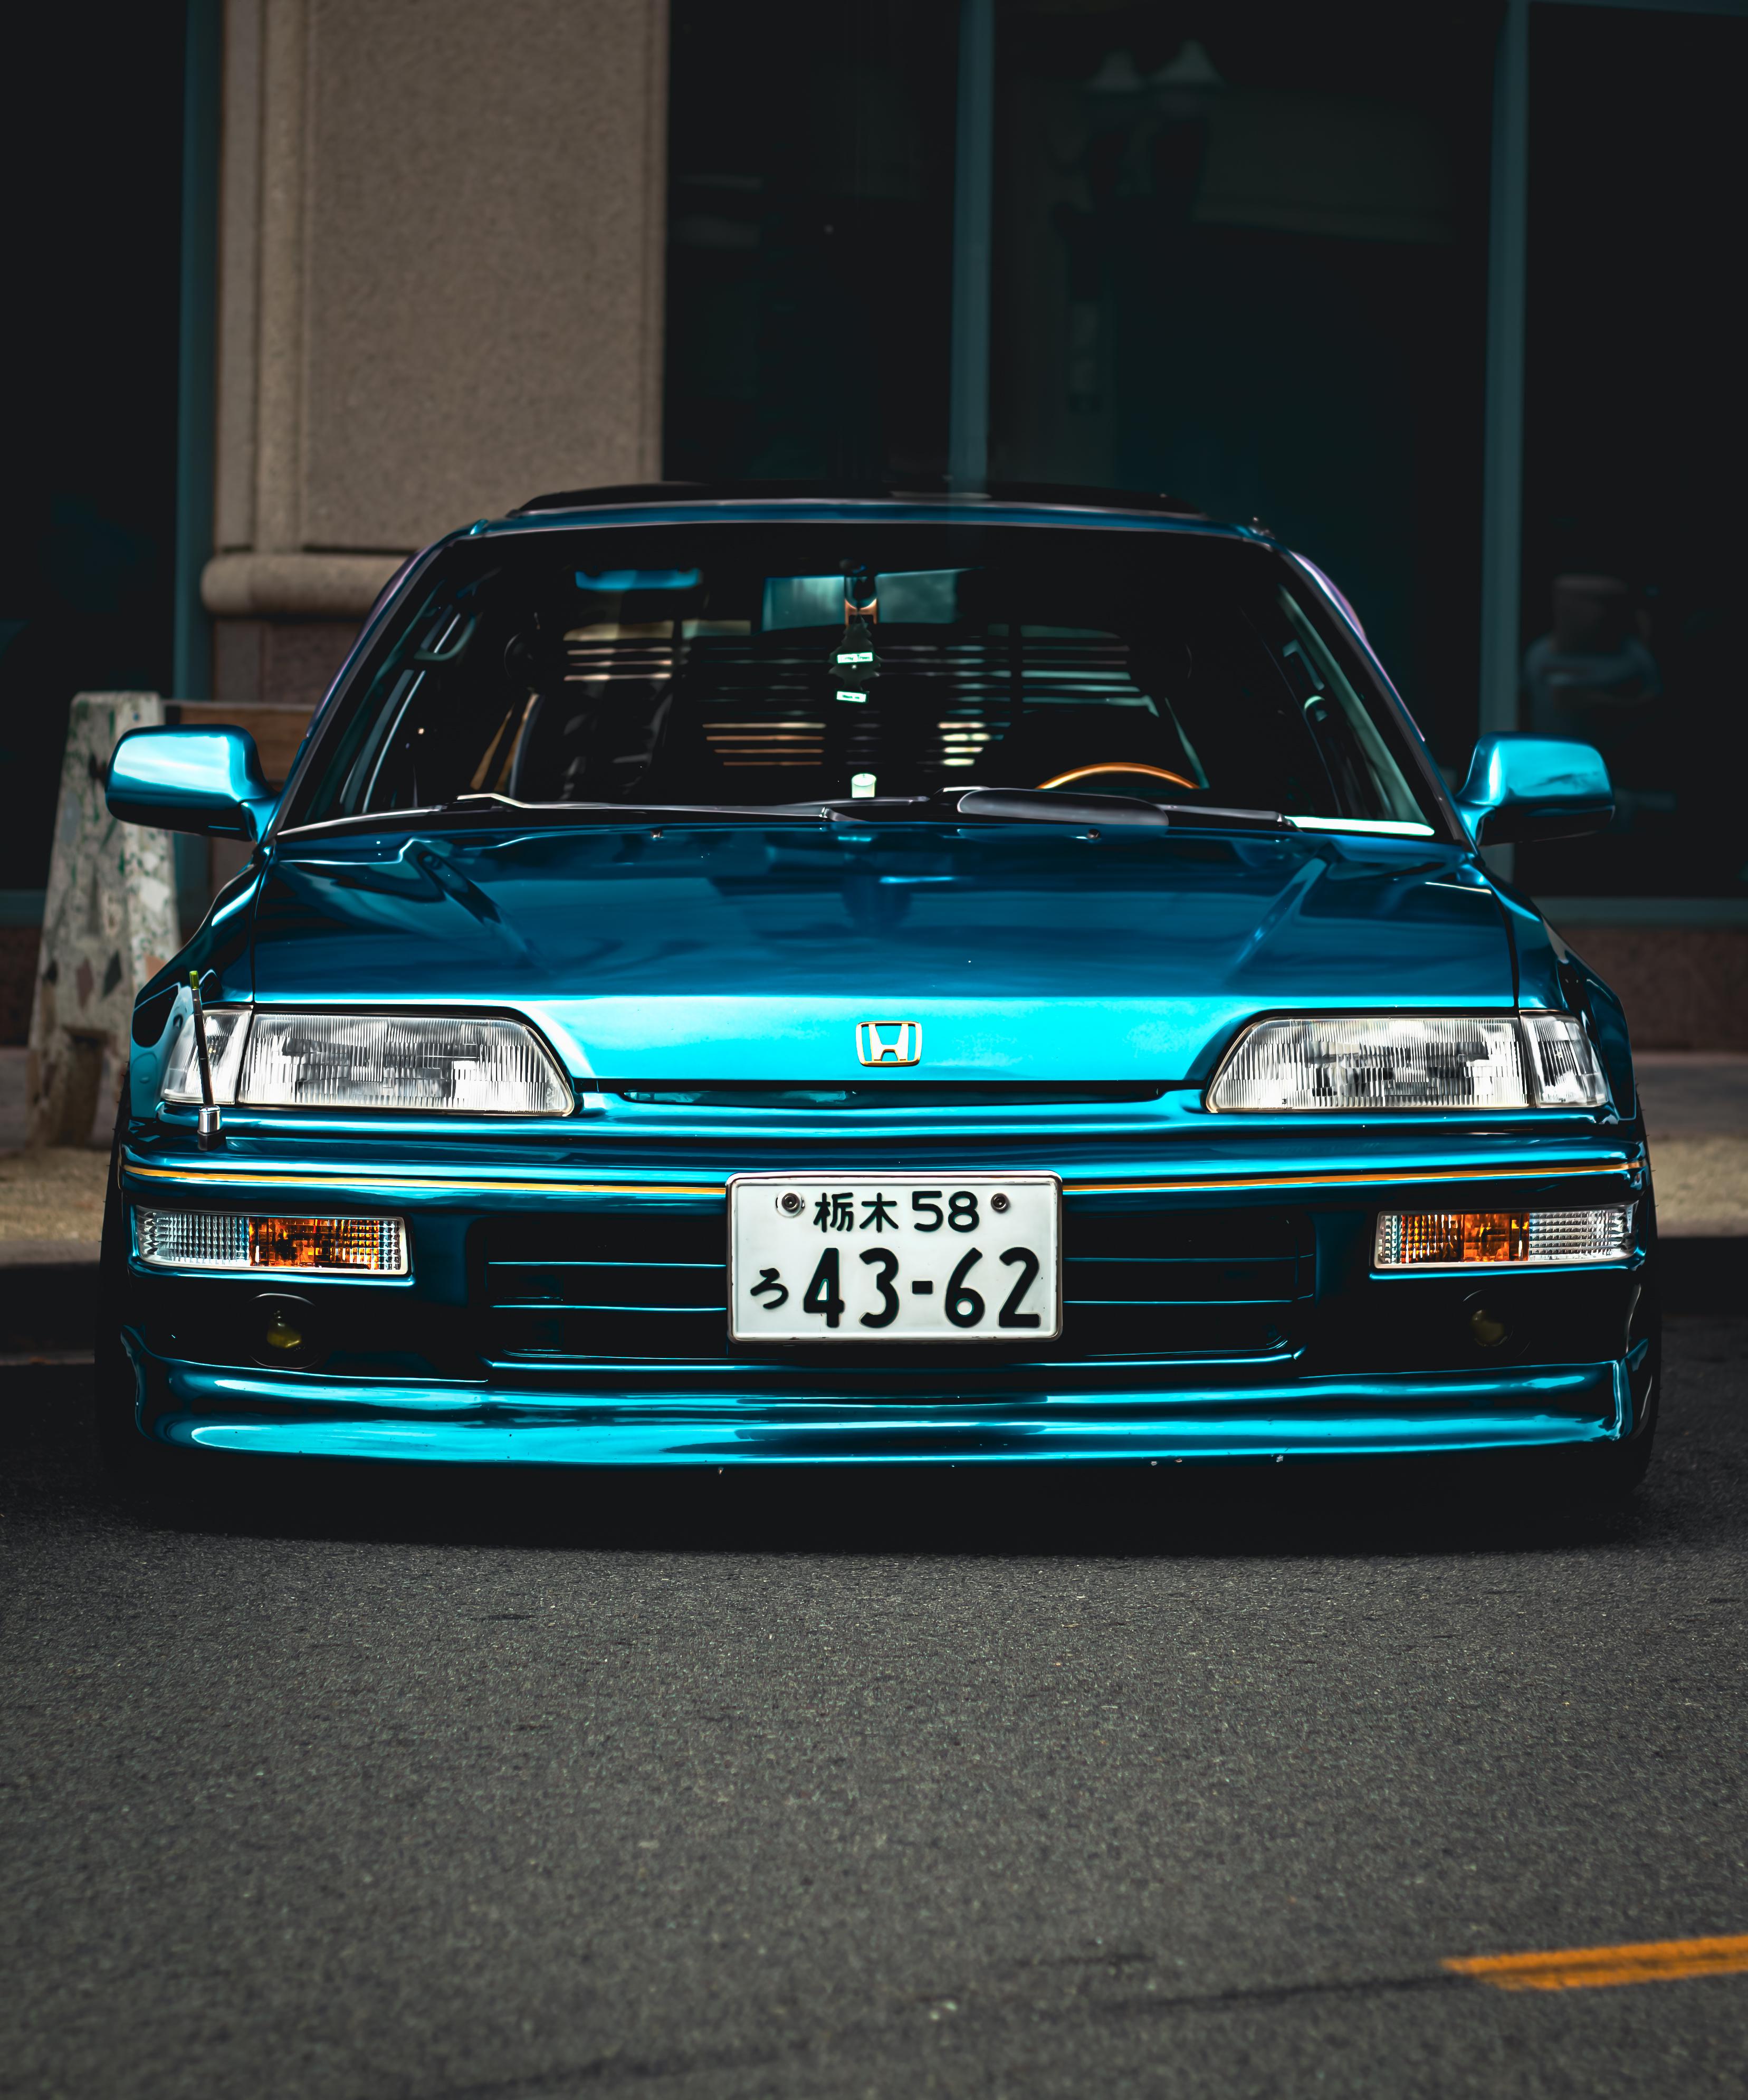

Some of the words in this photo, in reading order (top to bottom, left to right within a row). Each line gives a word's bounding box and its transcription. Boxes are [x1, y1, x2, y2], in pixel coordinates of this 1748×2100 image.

[813, 1192, 899, 1233] 栃木
[912, 1190, 980, 1233] 58
[750, 1267, 789, 1310] ろ
[803, 1246, 1041, 1329] 43-62
